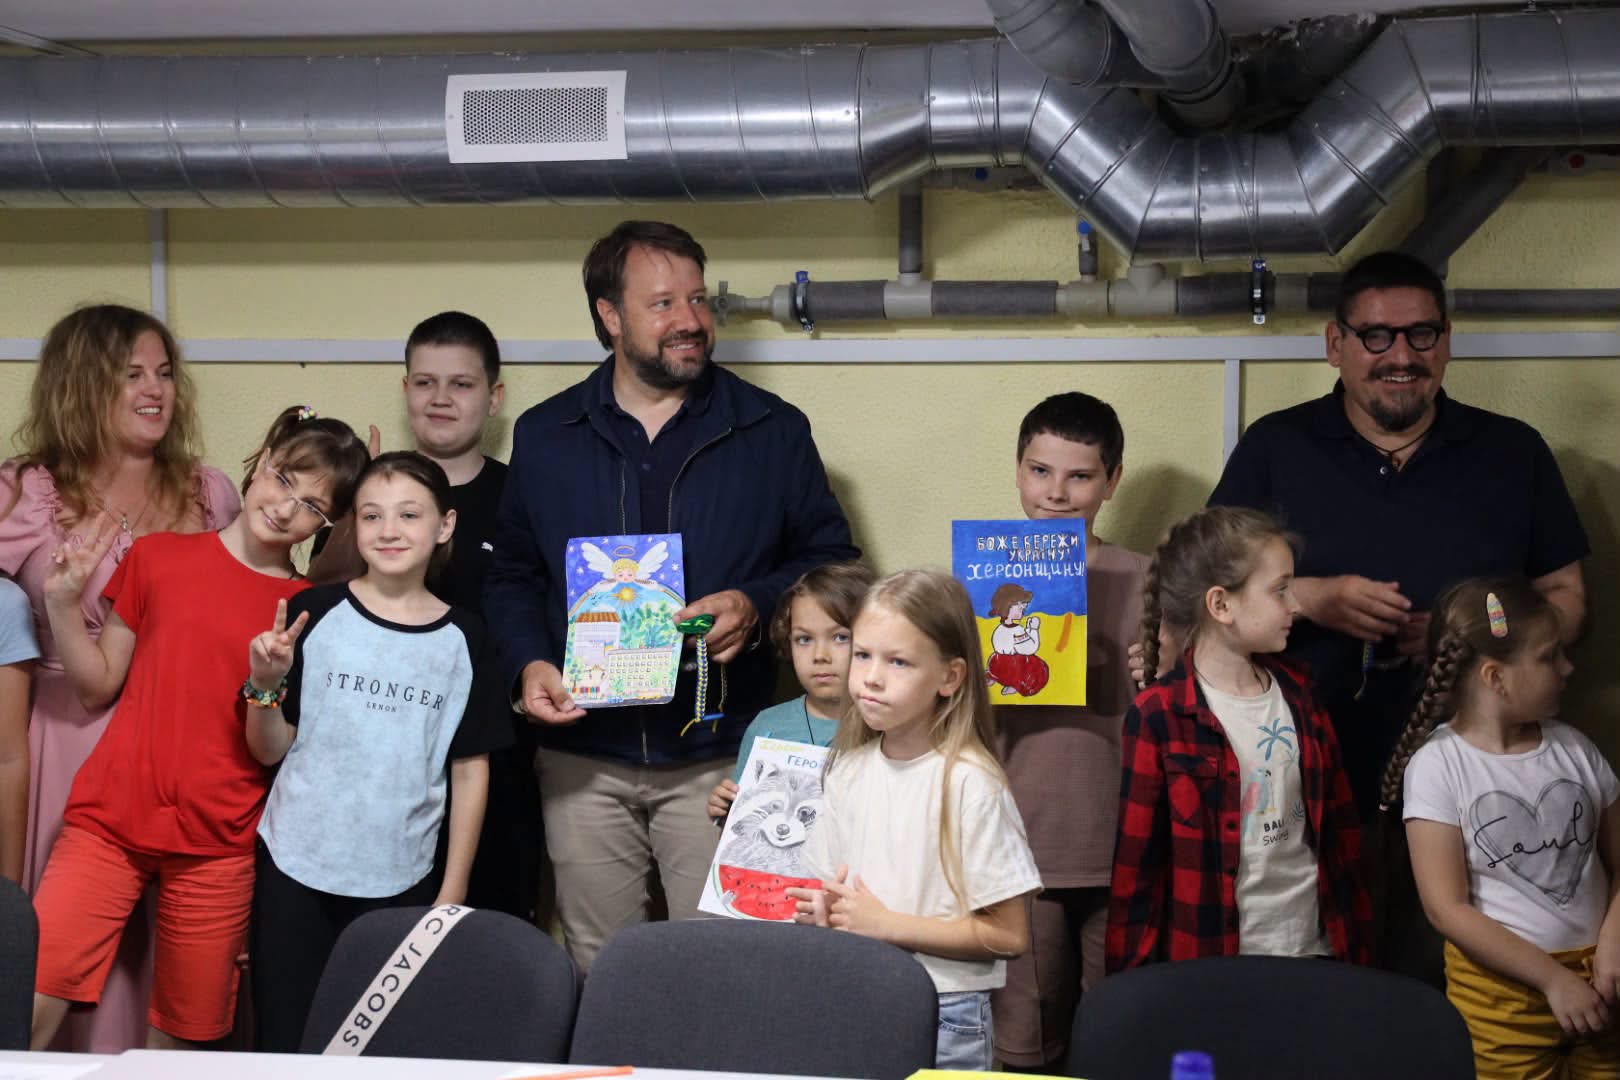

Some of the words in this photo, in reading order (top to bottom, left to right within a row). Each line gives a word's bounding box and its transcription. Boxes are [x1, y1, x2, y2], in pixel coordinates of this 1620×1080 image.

[977, 536, 1018, 551] БОЖЕ
[1024, 534, 1079, 550] БЕРЕЖИ
[326, 672, 444, 710] STRONGER
[343, 943, 422, 1047] JACOBS
